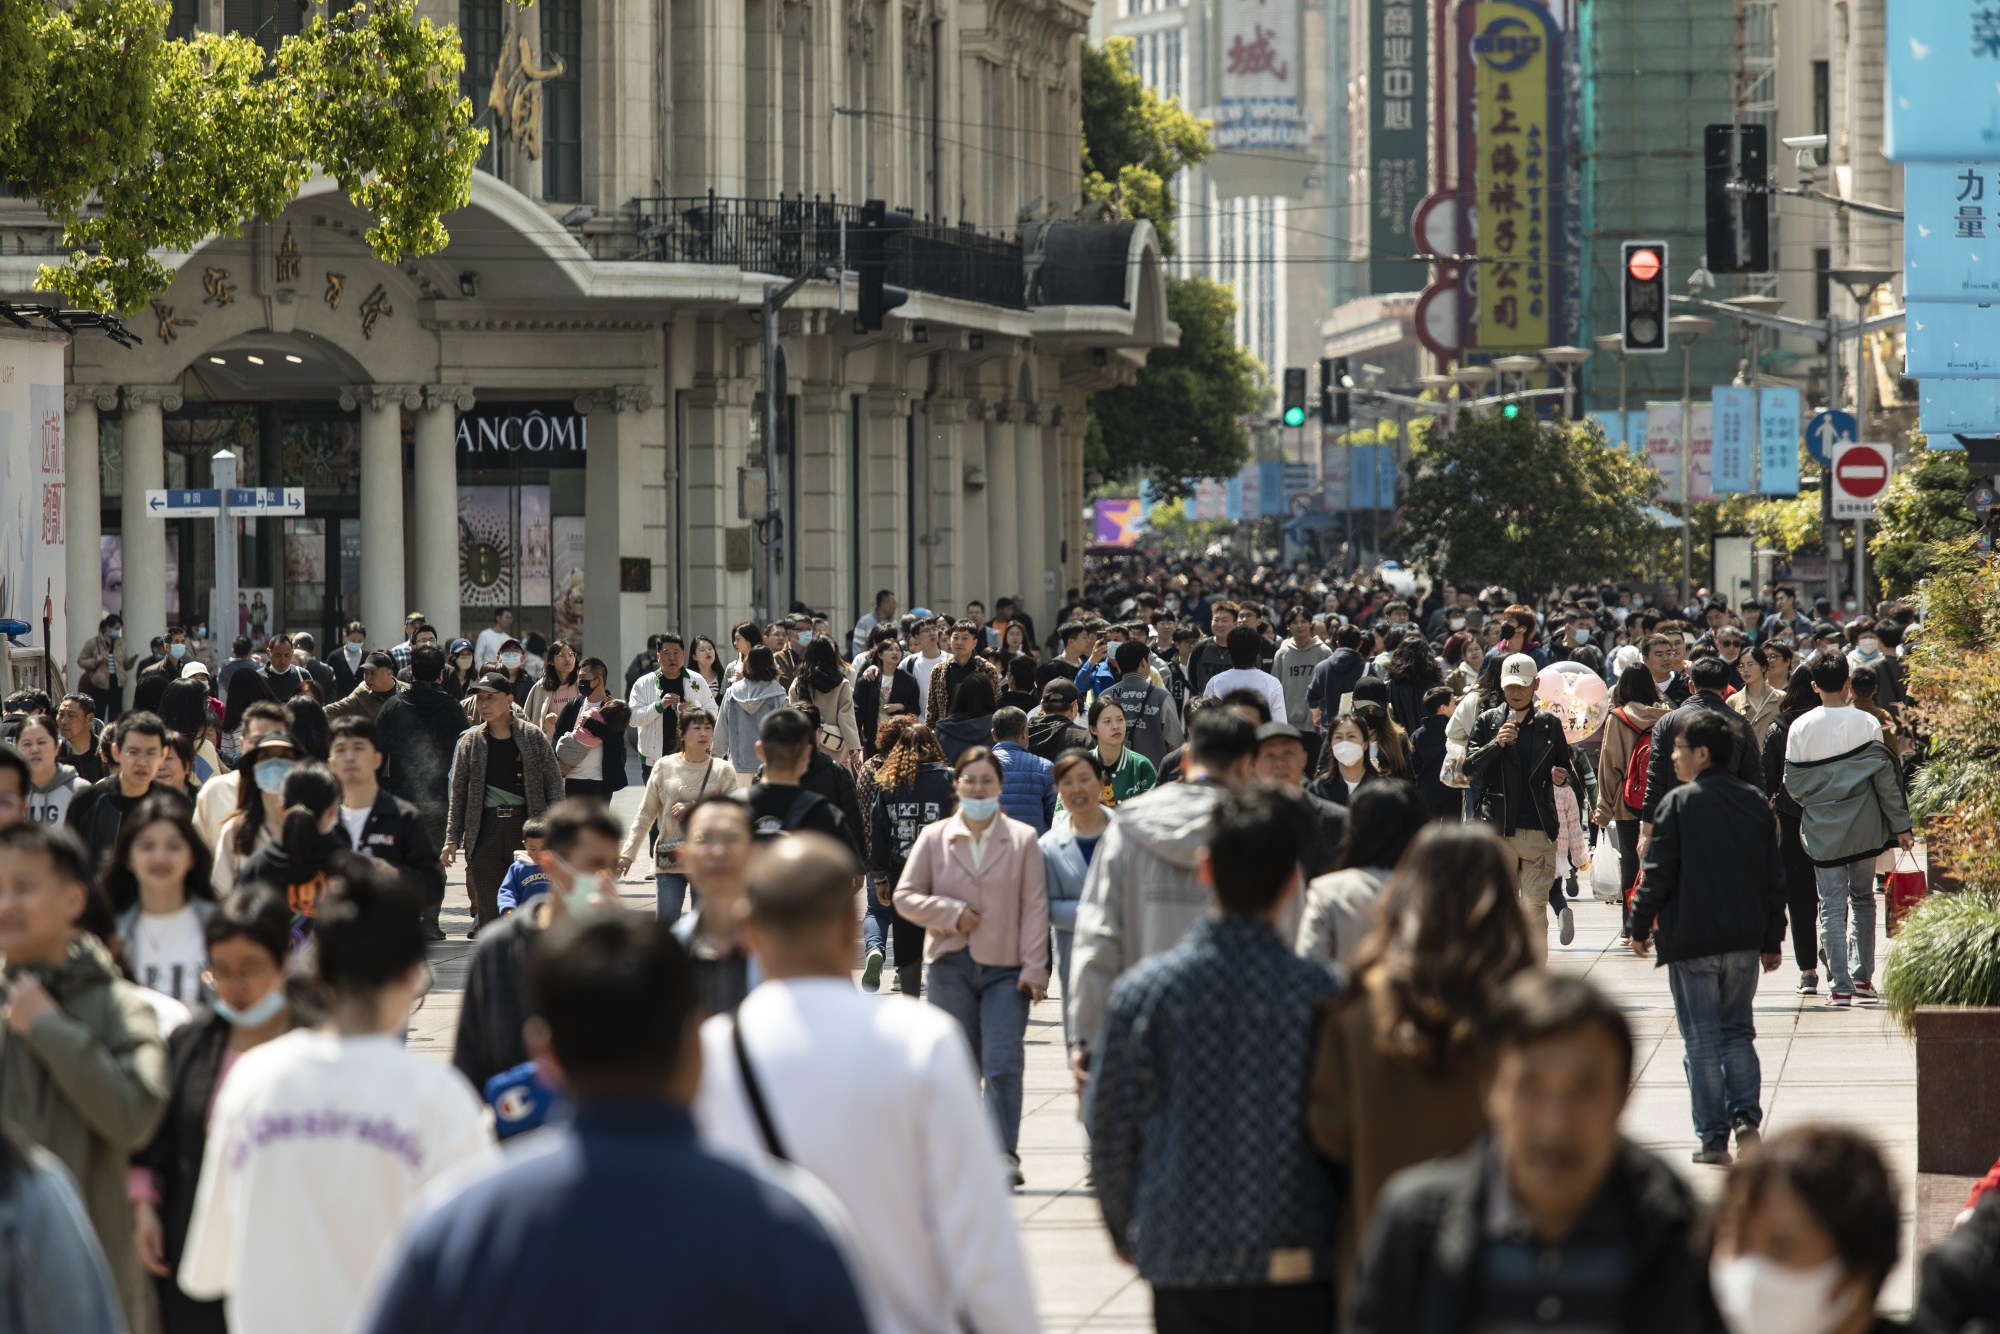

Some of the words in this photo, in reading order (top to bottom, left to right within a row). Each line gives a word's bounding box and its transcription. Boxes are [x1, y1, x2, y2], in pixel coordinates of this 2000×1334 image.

[1227, 0, 1288, 80] 城
[1384, 0, 1412, 130] 商业中心
[1954, 160, 1987, 238] 力量
[455, 409, 587, 452] ANCÔM
[1112, 686, 1147, 699] Never
[1289, 664, 1314, 677] 1977
